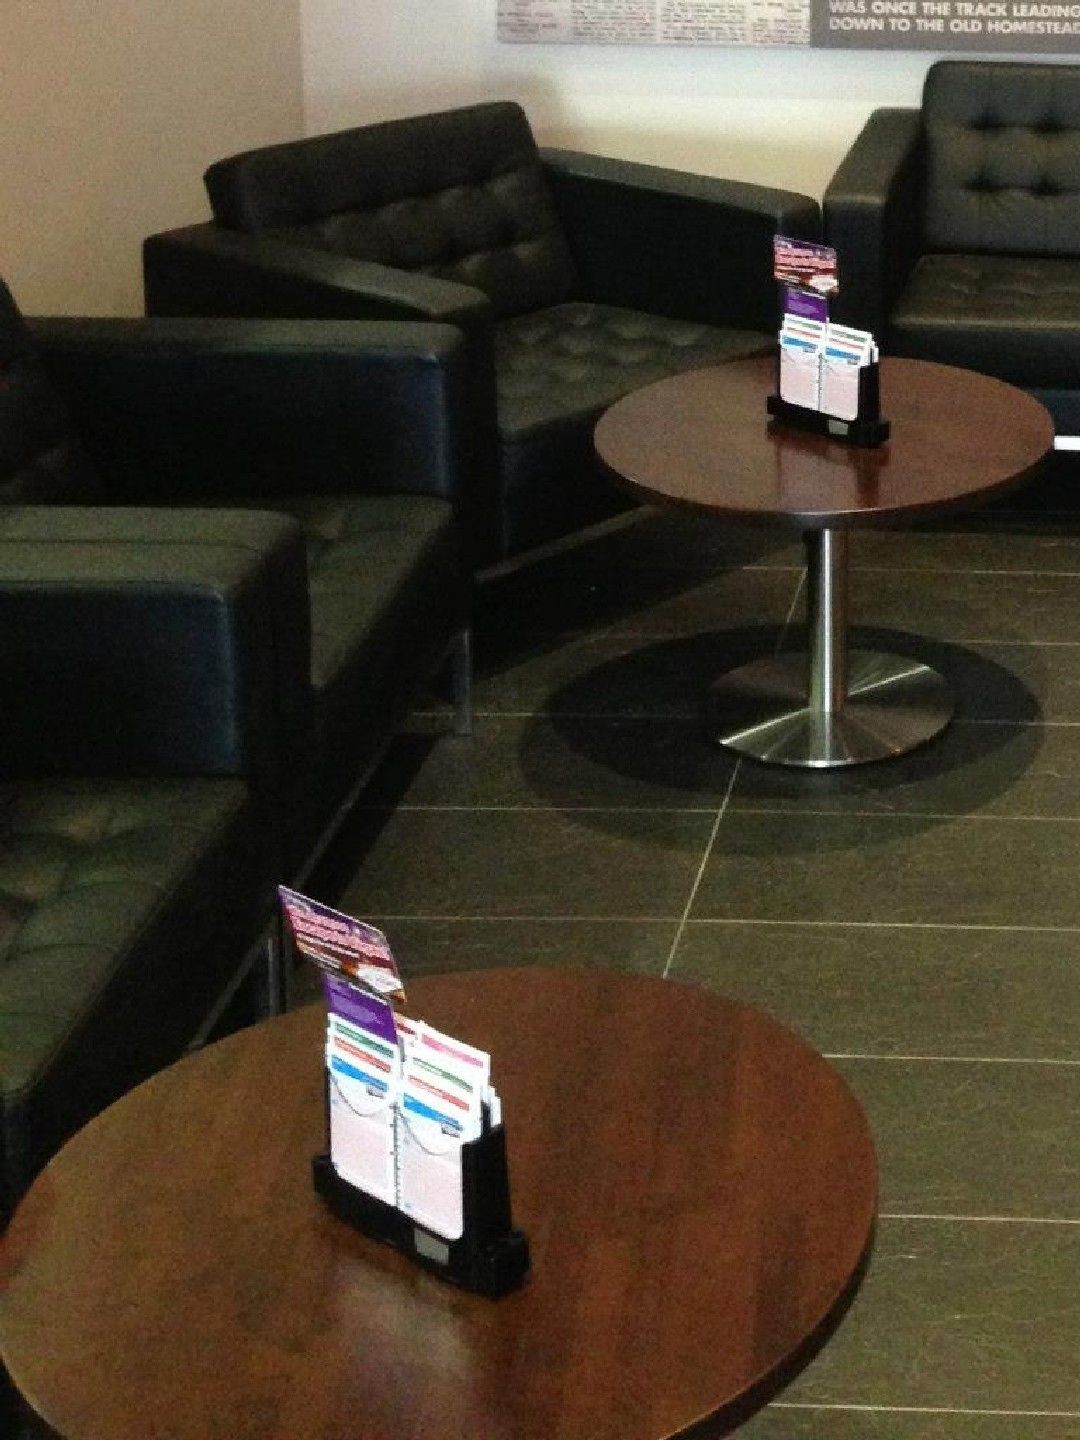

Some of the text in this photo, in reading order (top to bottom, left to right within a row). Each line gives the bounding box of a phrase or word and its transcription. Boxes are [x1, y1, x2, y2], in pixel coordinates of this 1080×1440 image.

[828, 0, 866, 14] WAS
[871, 0, 917, 15] ONCE
[922, 1, 951, 16] THE
[954, 2, 1007, 17] TRACK
[828, 16, 885, 31] DOWN
[889, 17, 911, 31] TO
[916, 18, 945, 32] THE
[949, 19, 982, 33] OLD
